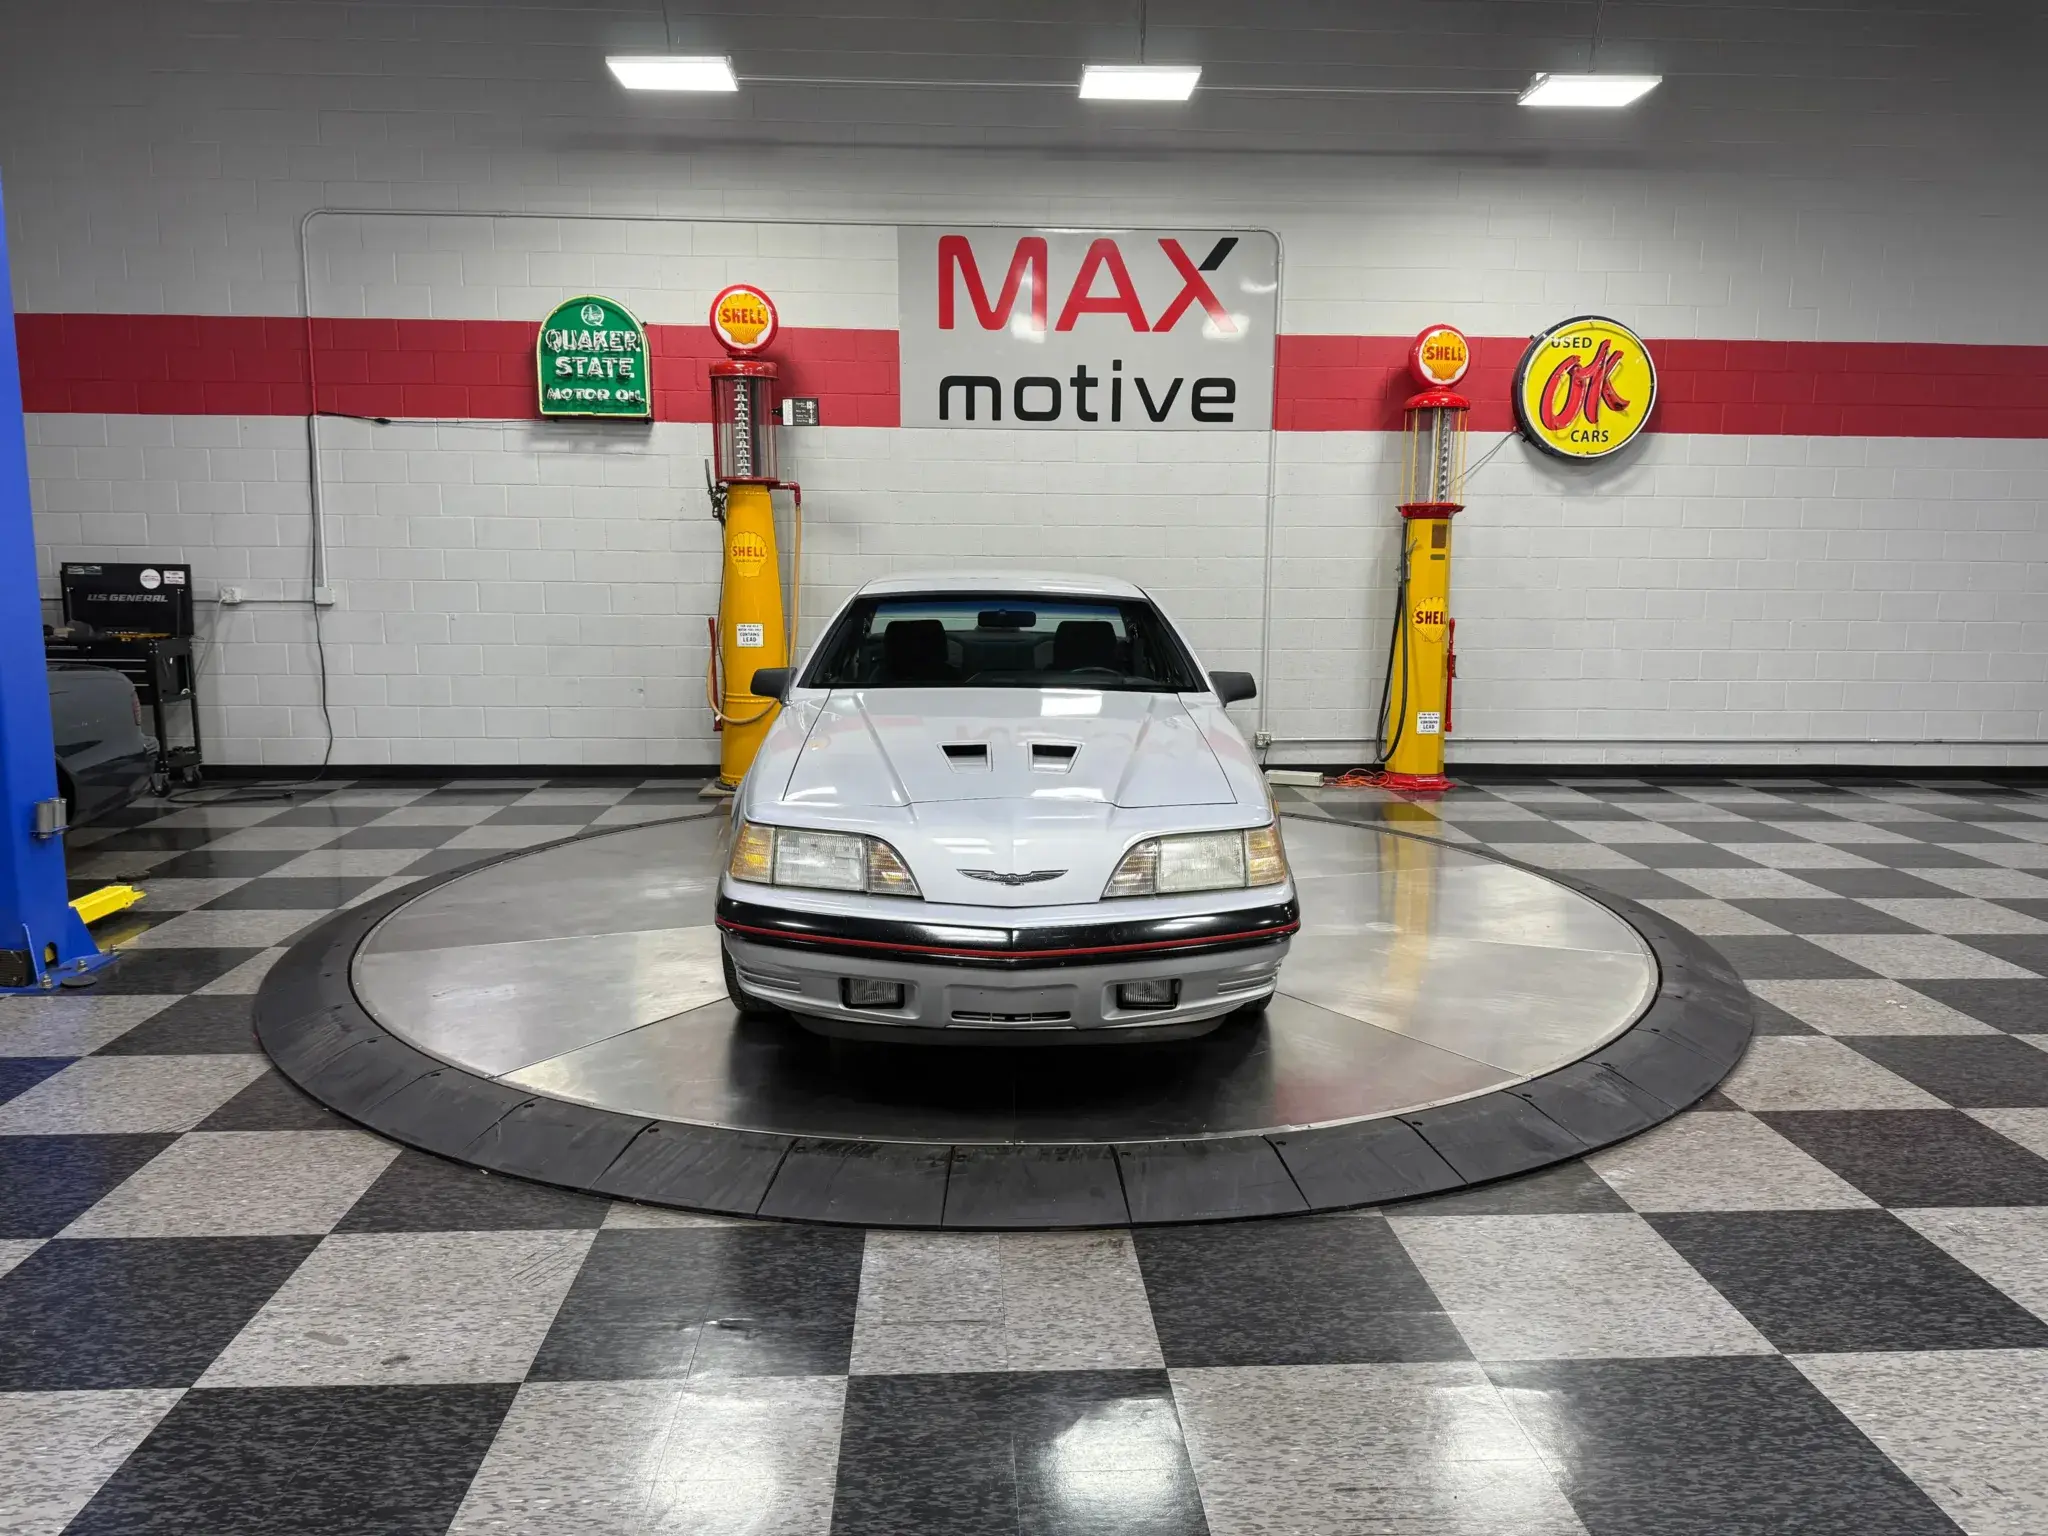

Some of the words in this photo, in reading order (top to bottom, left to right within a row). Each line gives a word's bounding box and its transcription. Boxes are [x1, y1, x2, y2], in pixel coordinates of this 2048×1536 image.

[938, 235, 1239, 332] MAX
[722, 308, 765, 325] SHELL
[545, 329, 641, 353] QUAKER
[1551, 336, 1593, 349] USED
[1426, 345, 1464, 362] SHELL
[555, 356, 635, 378] STATE
[546, 387, 610, 401] MOTOR
[615, 389, 645, 402] OIL
[939, 359, 1236, 422] motive
[1570, 430, 1609, 443] CARS
[732, 546, 765, 557] SHELL
[109, 594, 168, 602] GENERAL
